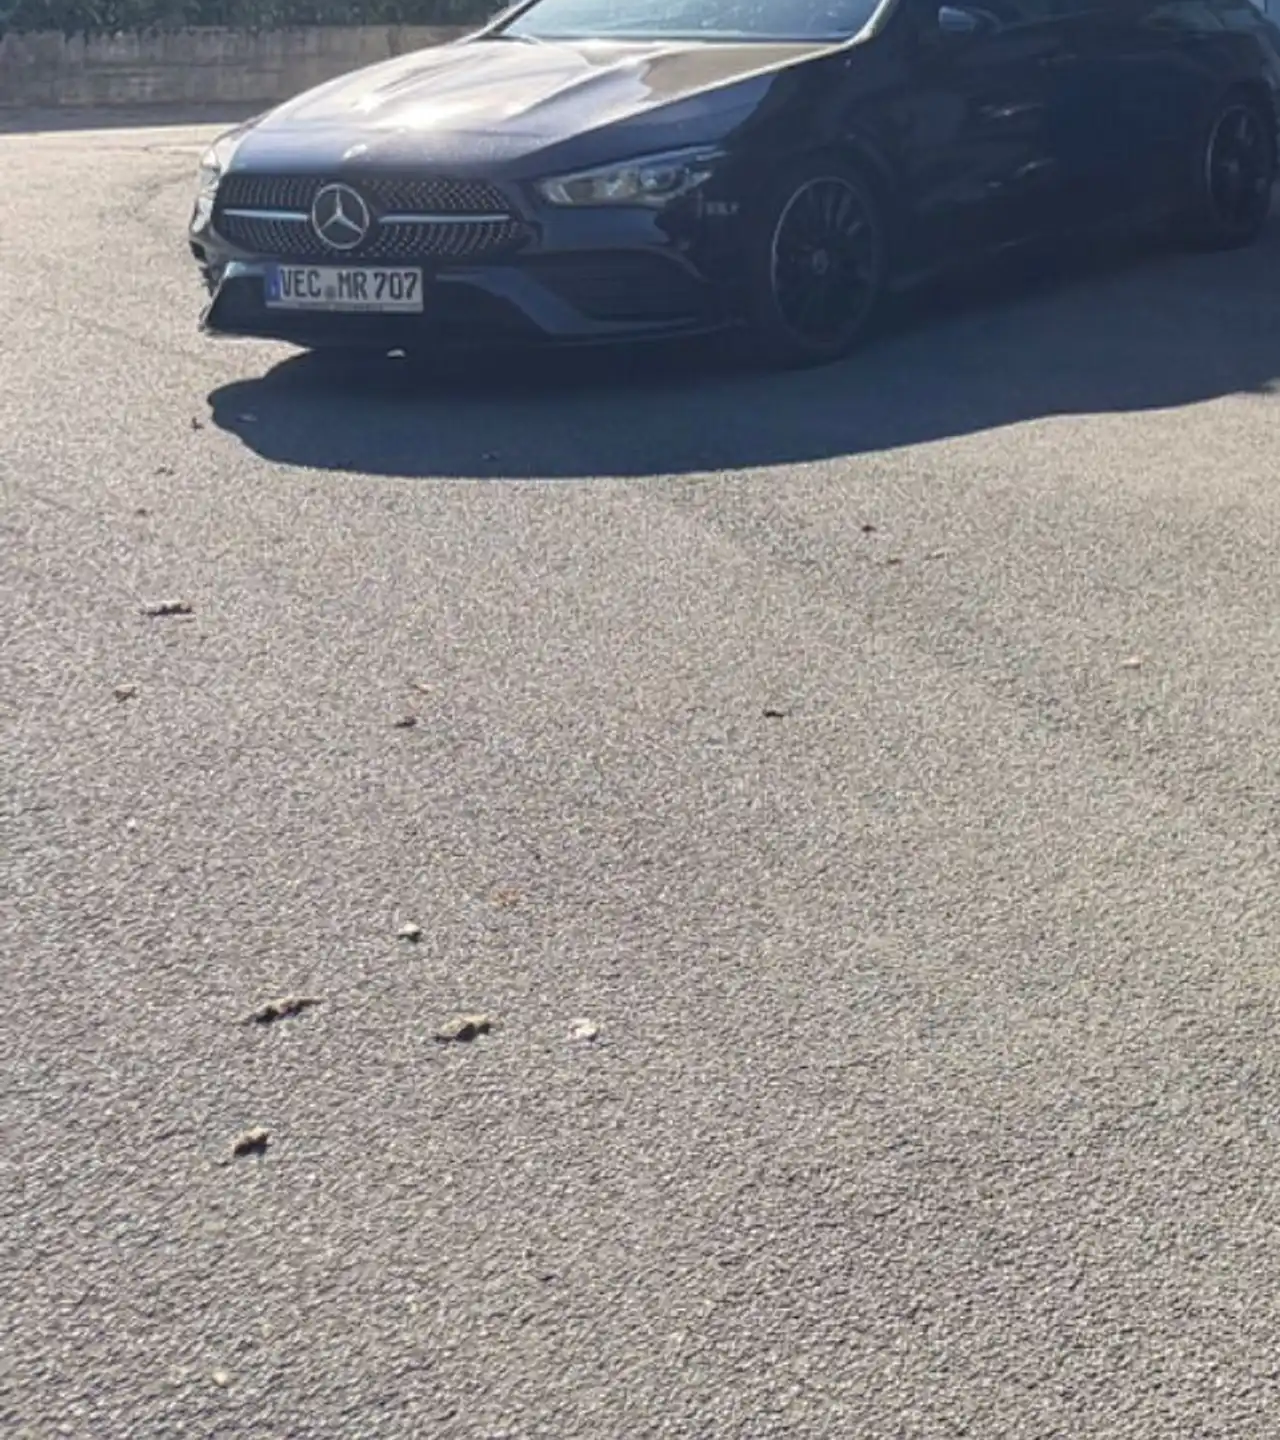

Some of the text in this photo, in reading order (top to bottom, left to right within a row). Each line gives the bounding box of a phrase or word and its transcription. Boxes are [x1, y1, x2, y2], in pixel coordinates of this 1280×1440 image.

[279, 268, 418, 300] VEC MR 707
